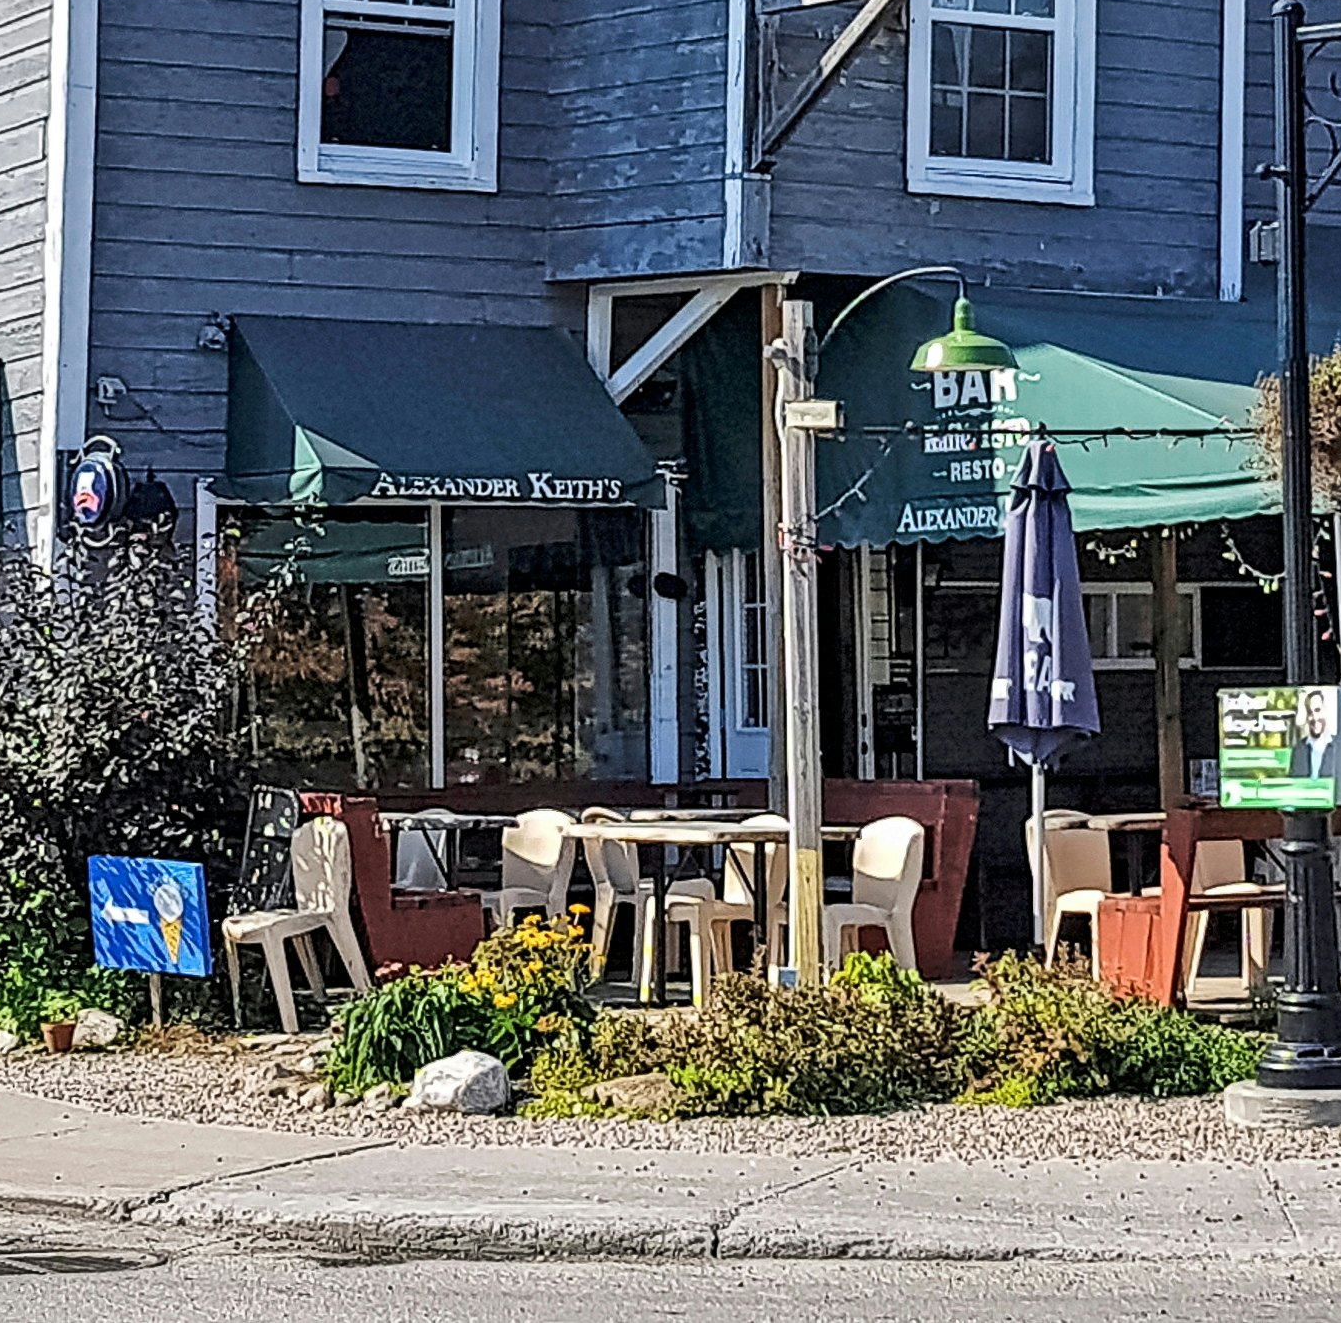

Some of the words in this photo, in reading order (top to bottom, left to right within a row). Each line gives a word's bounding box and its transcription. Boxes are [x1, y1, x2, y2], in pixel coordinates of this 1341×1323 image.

[932, 368, 1019, 409] BAR
[950, 457, 1005, 482] RESTO
[371, 471, 521, 497] ALEXANDER
[527, 473, 623, 499] KEITH'S
[896, 502, 999, 534] ALEXANDER
